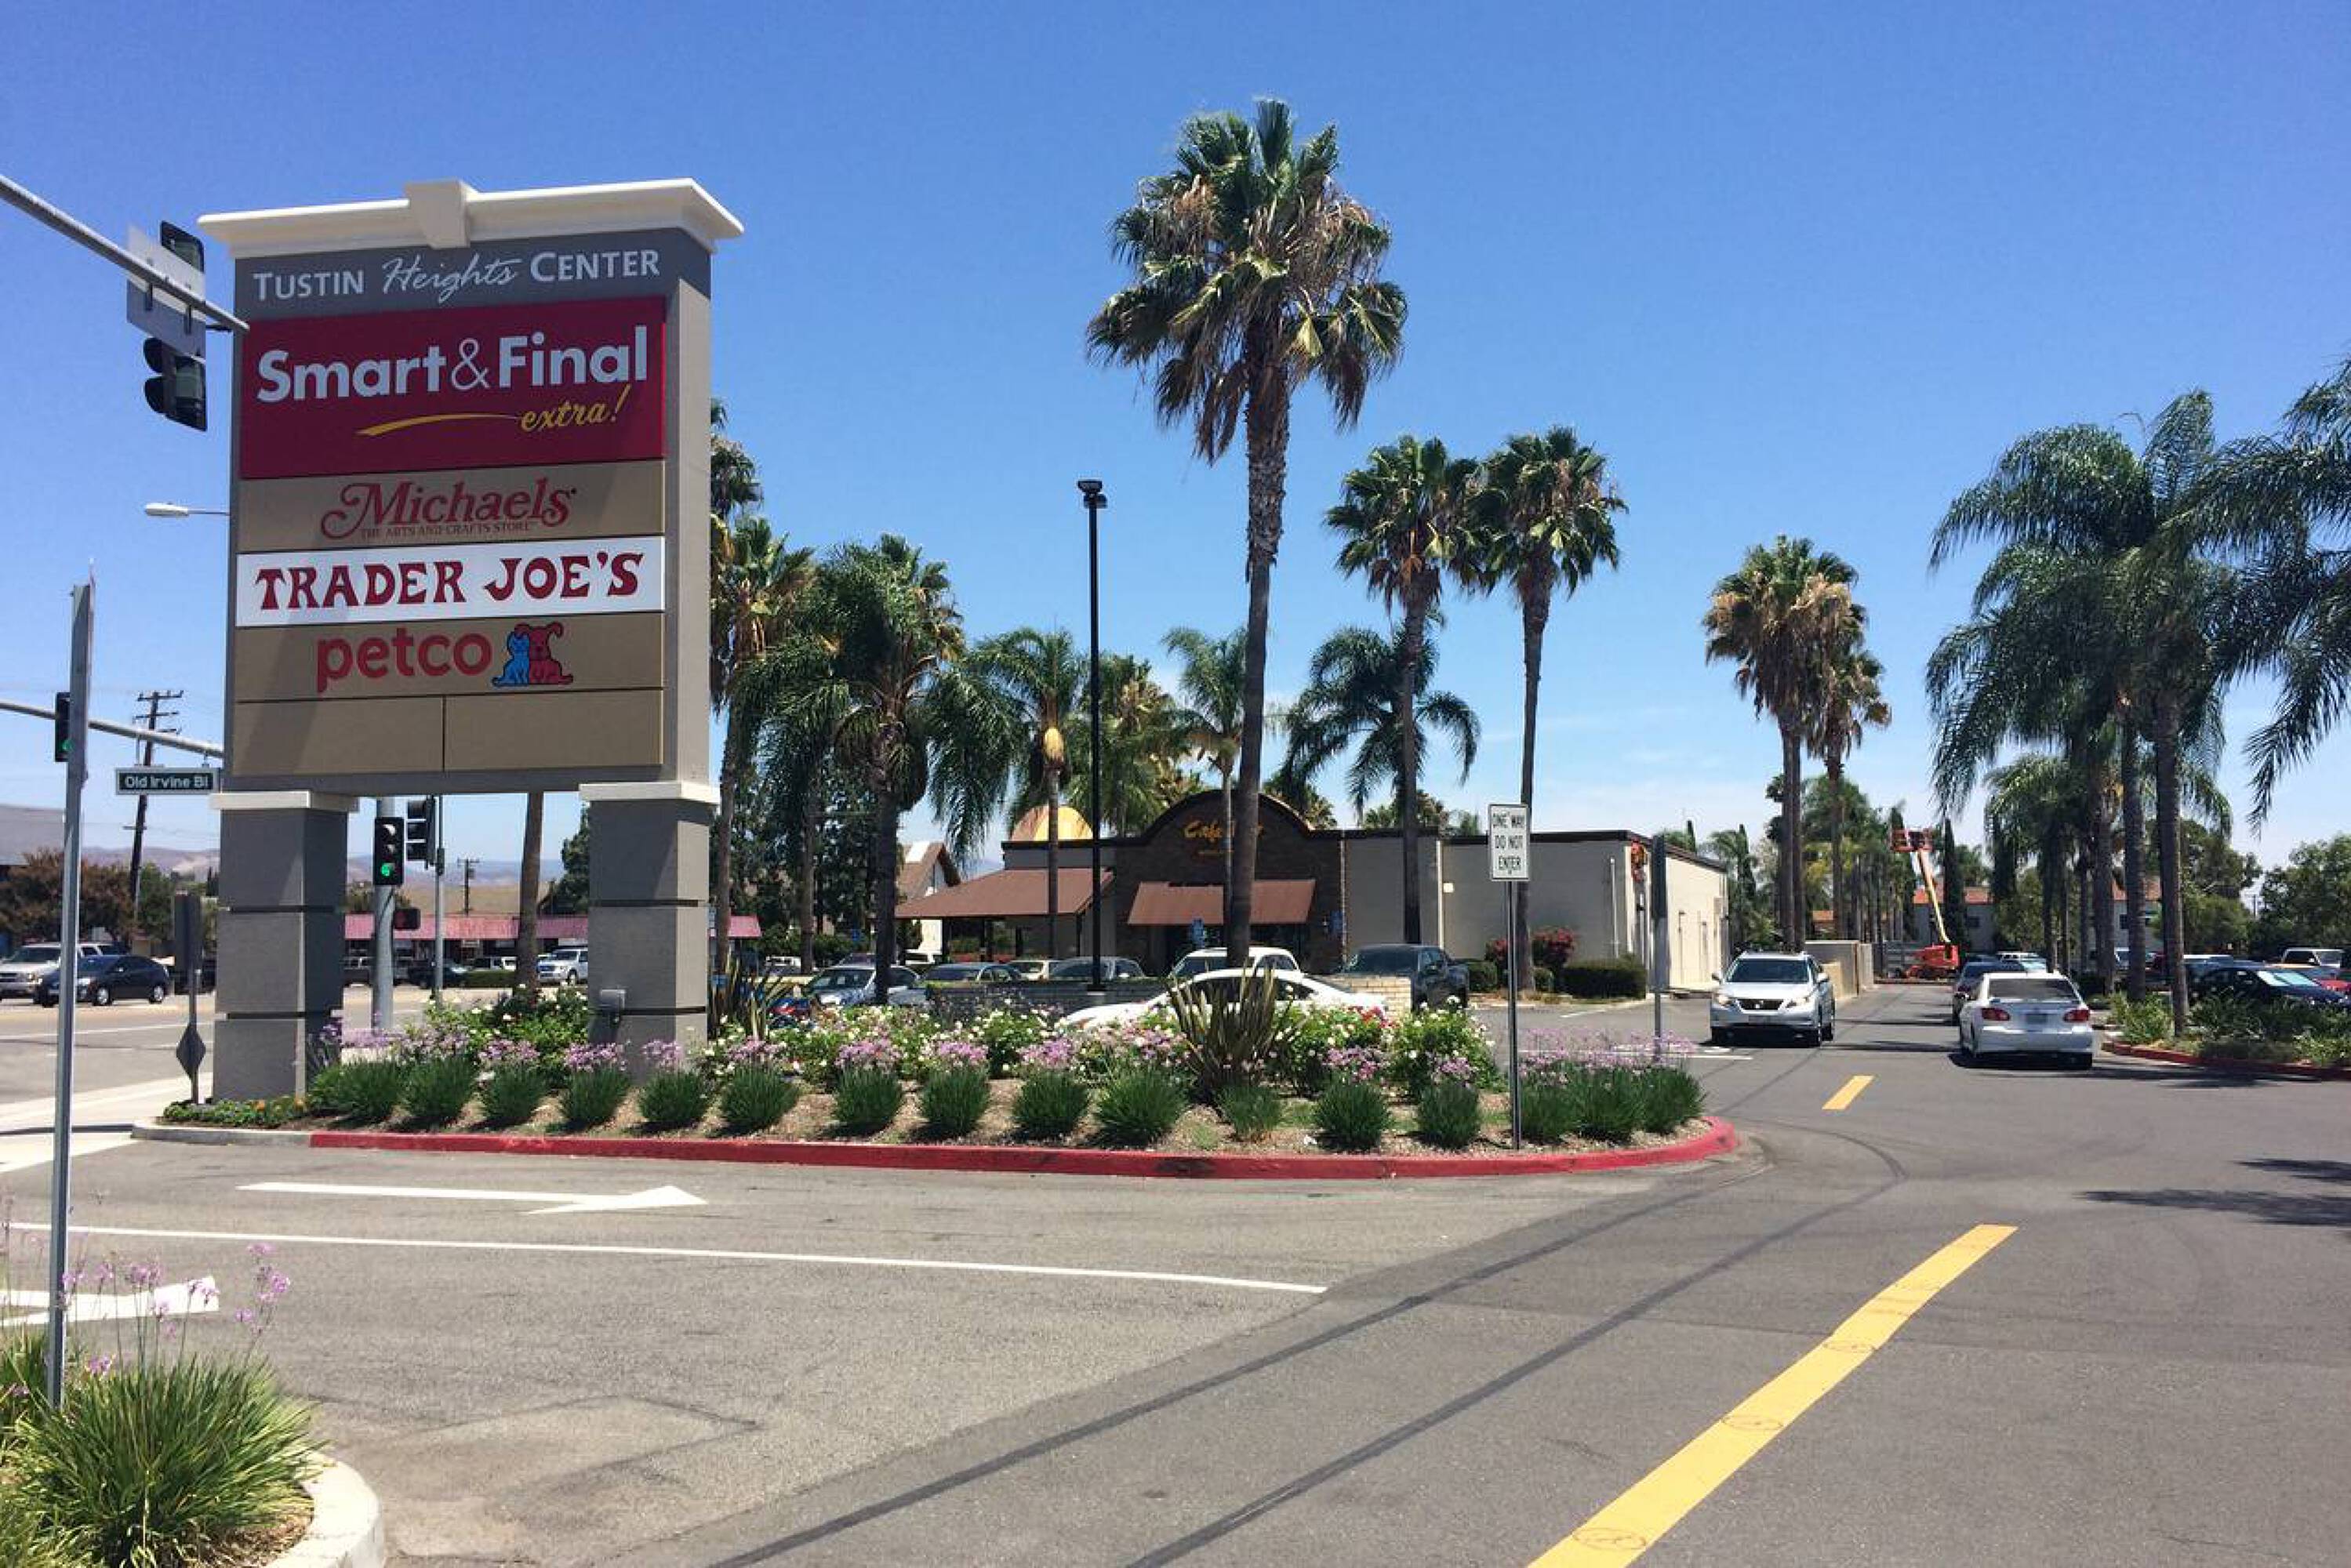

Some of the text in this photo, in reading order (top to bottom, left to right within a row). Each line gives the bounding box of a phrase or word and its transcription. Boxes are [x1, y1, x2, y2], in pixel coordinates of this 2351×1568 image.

[381, 254, 522, 303] Heights
[521, 383, 632, 434] extra!
[320, 477, 570, 539] Michaels
[385, 526, 416, 537] ARTS
[418, 524, 441, 535] AND
[445, 523, 492, 535] CRAFTS
[493, 521, 530, 533] STORE
[255, 551, 644, 611] TRADER JOE'S
[316, 628, 492, 694] petco
[125, 775, 208, 789] Old Irvine Bl
[1494, 834, 1524, 849] DO NOT
[1498, 855, 1521, 871] ENTER
